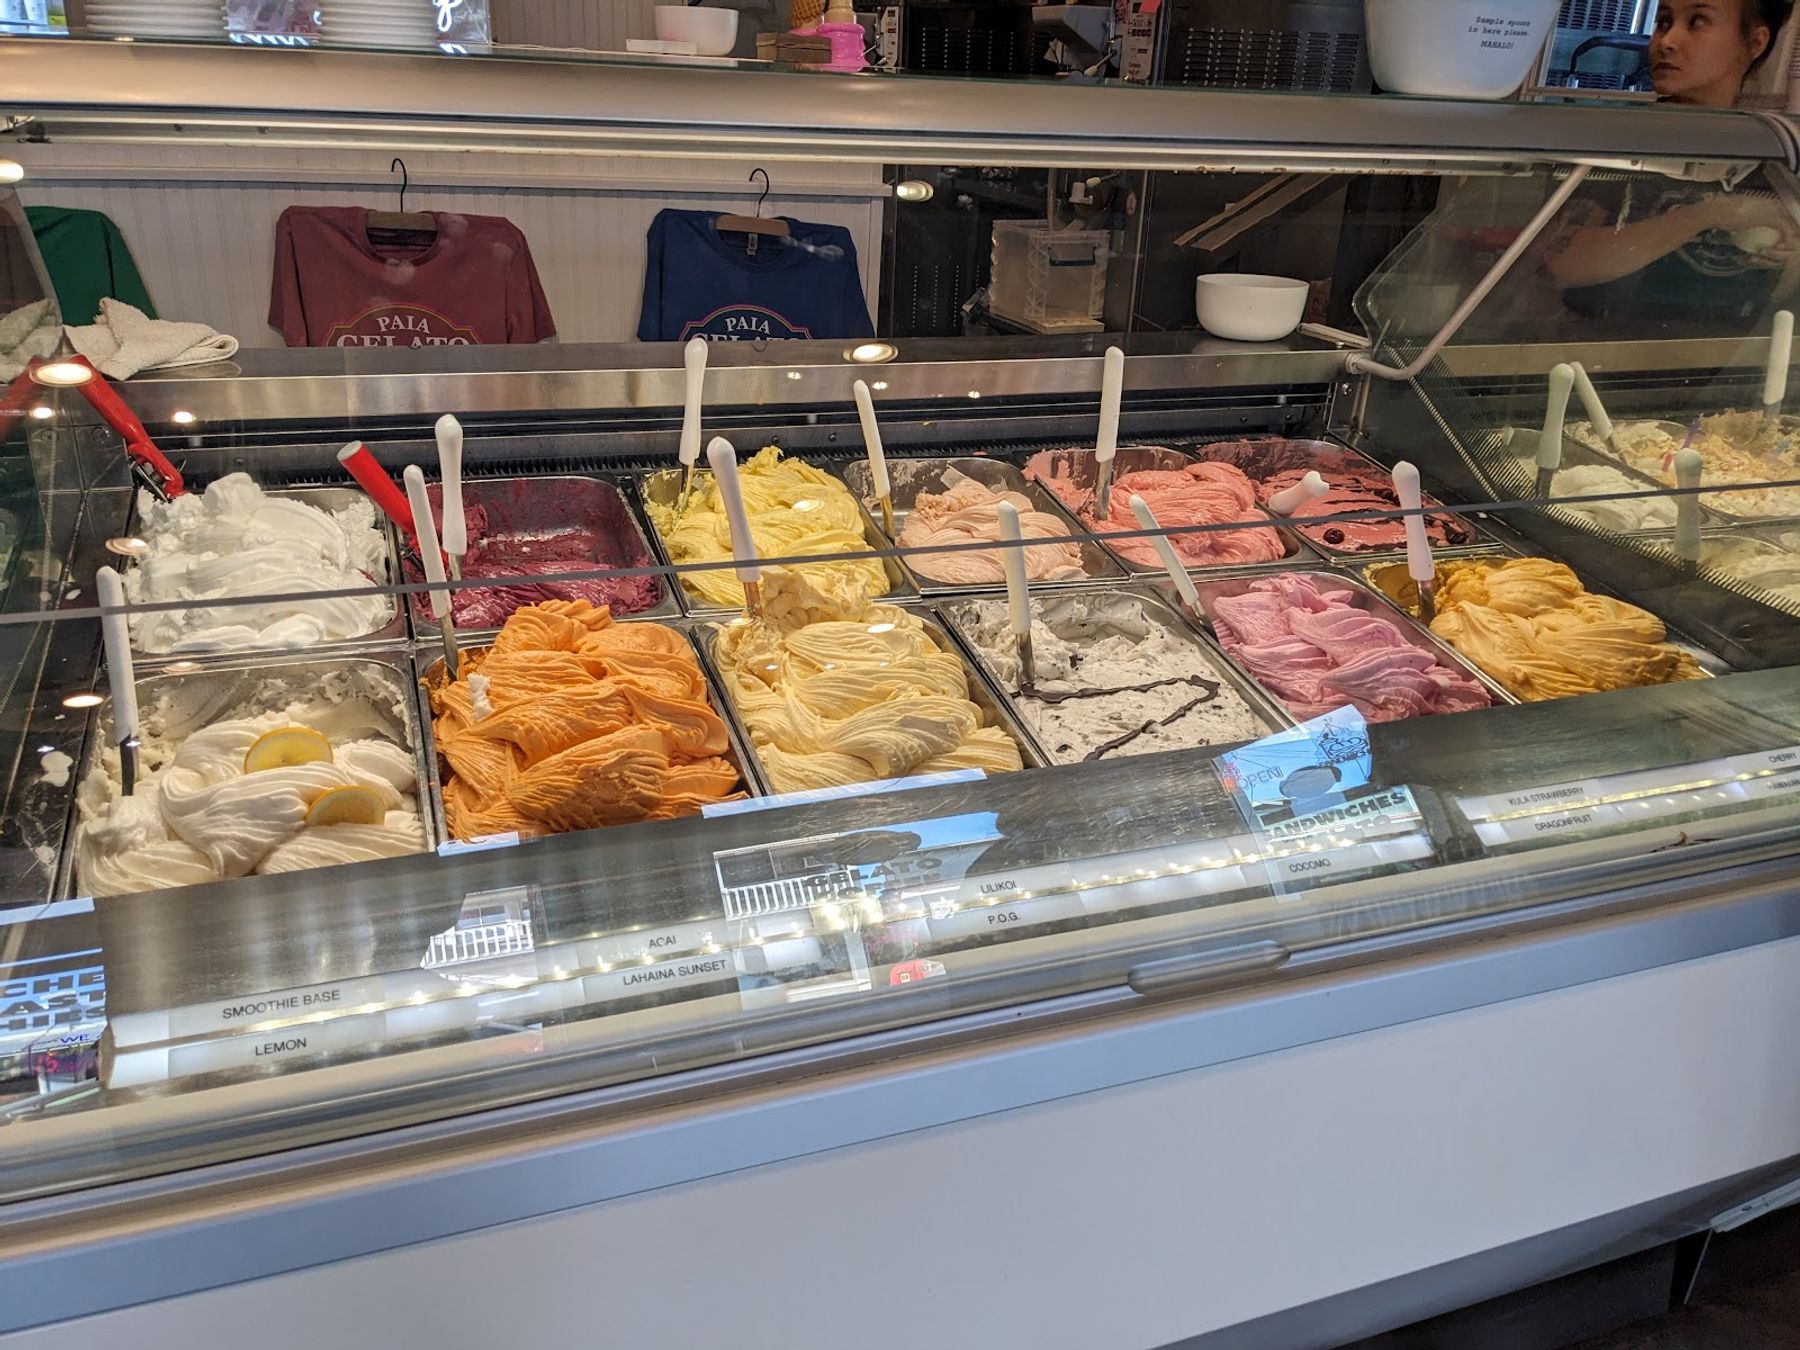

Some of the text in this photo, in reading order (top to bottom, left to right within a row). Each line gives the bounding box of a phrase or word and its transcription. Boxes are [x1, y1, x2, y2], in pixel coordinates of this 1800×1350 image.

[1480, 40, 1515, 50] MAHALO!
[376, 315, 431, 334] PAIA
[724, 316, 771, 335] PAIA
[1508, 786, 1585, 807] KULA STRAWBERRY
[1534, 814, 1593, 832] DRAGONFRUIT
[1288, 858, 1331, 873] COCOMO
[980, 880, 1017, 895] LILIKOI
[987, 912, 1021, 925] P.O.G.
[650, 935, 677, 949] ACAI
[622, 959, 727, 986] LAHAINA SUNSET
[222, 989, 341, 1020] SMOOTHIE BASE
[255, 1037, 308, 1057] LEMON
